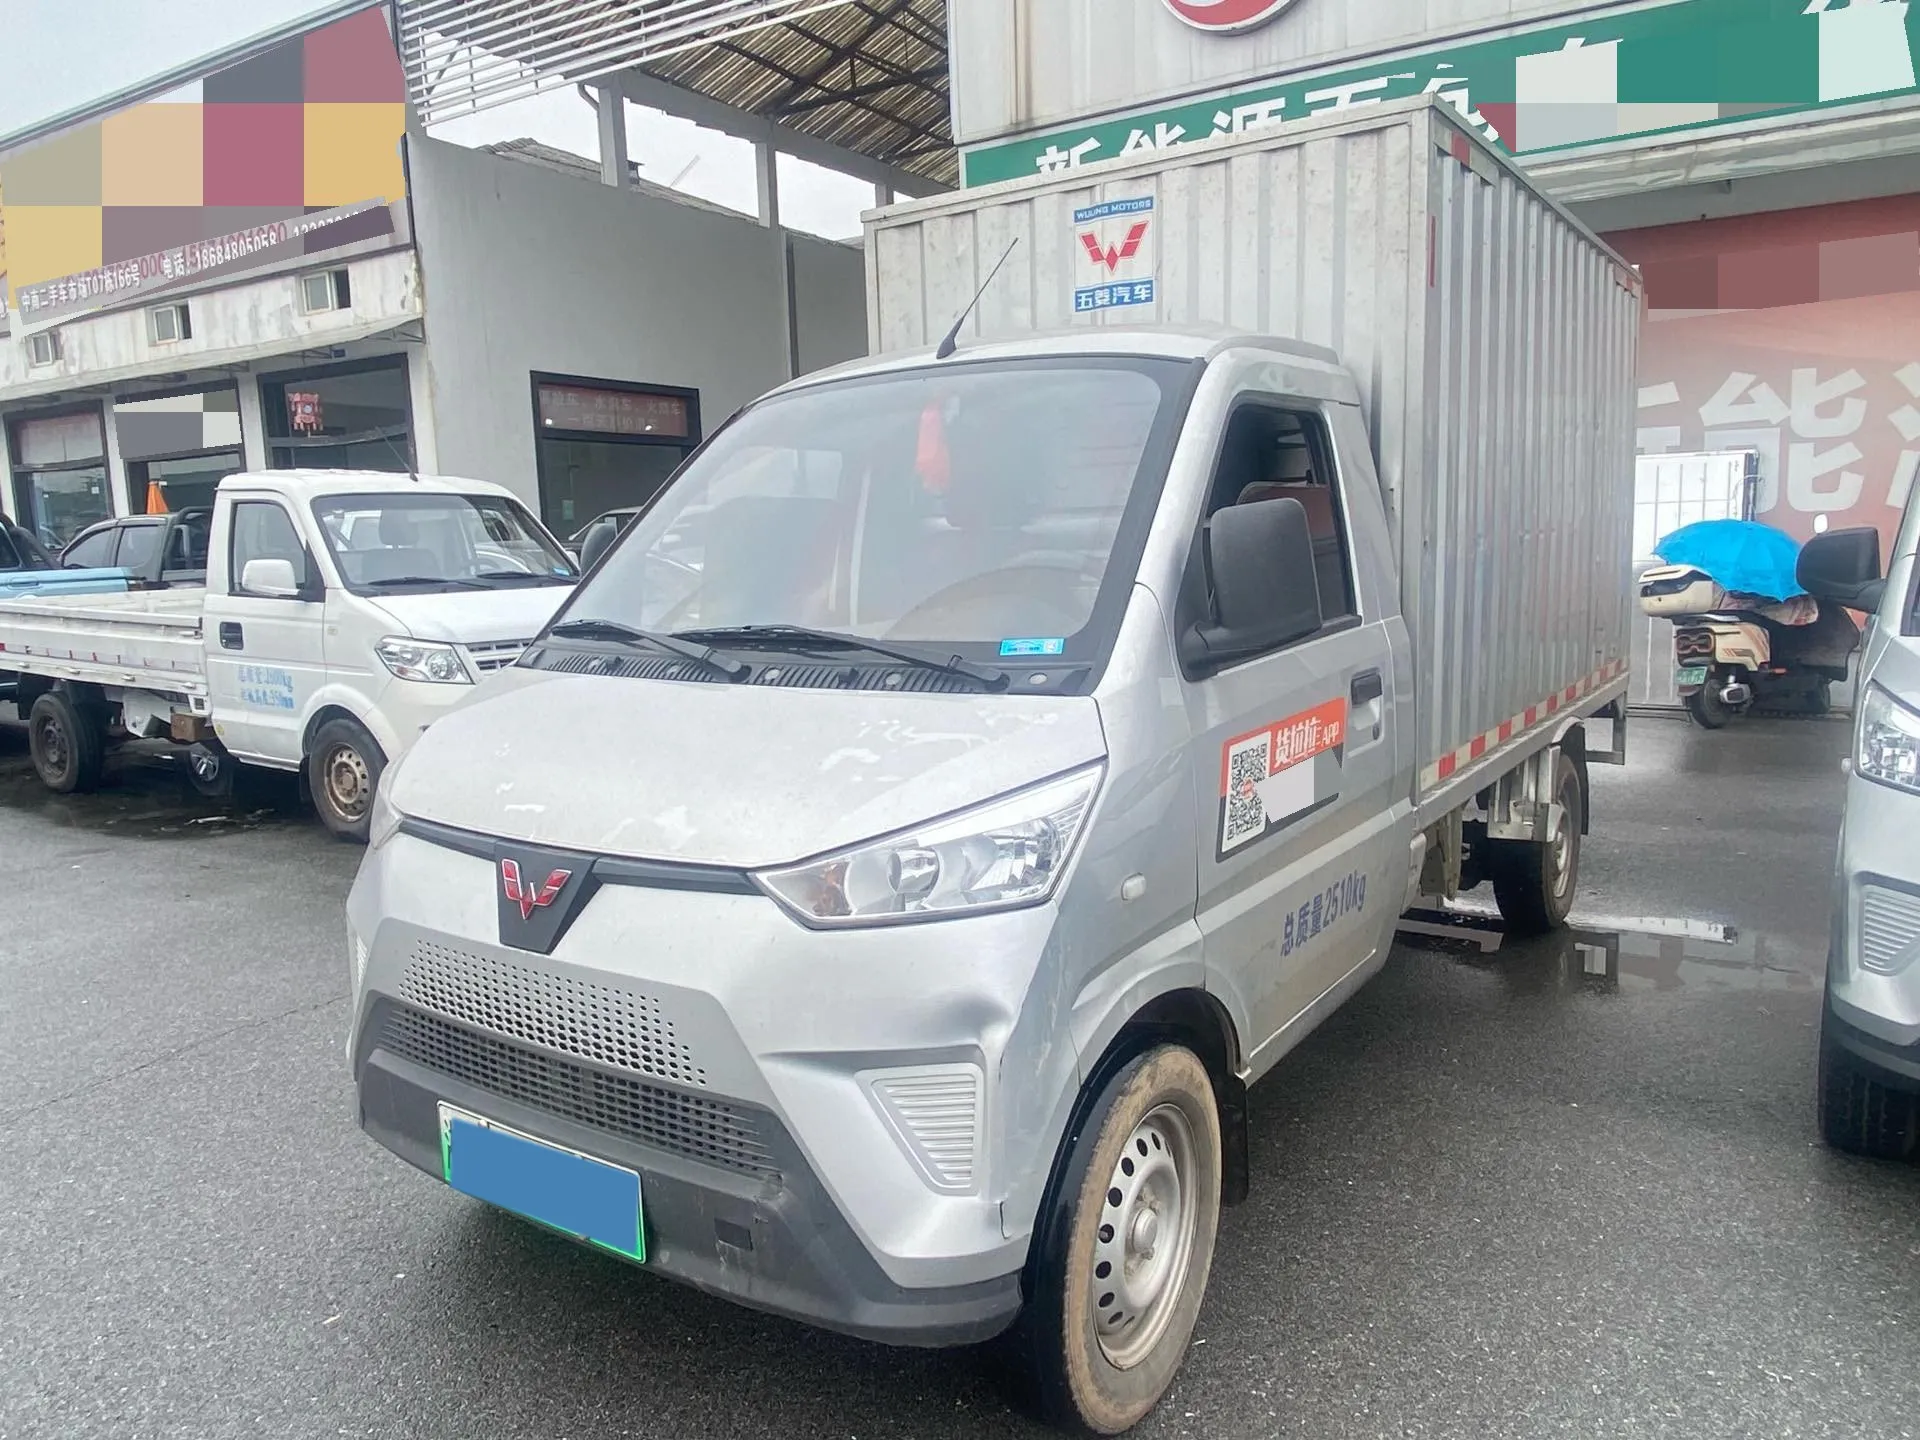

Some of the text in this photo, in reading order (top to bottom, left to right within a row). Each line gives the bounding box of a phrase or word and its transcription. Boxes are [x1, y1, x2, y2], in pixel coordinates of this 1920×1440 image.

[1111, 199, 1152, 213] MOTORS
[1077, 284, 1152, 309] 五菱汽车
[1273, 715, 1321, 769] 货拉拉
